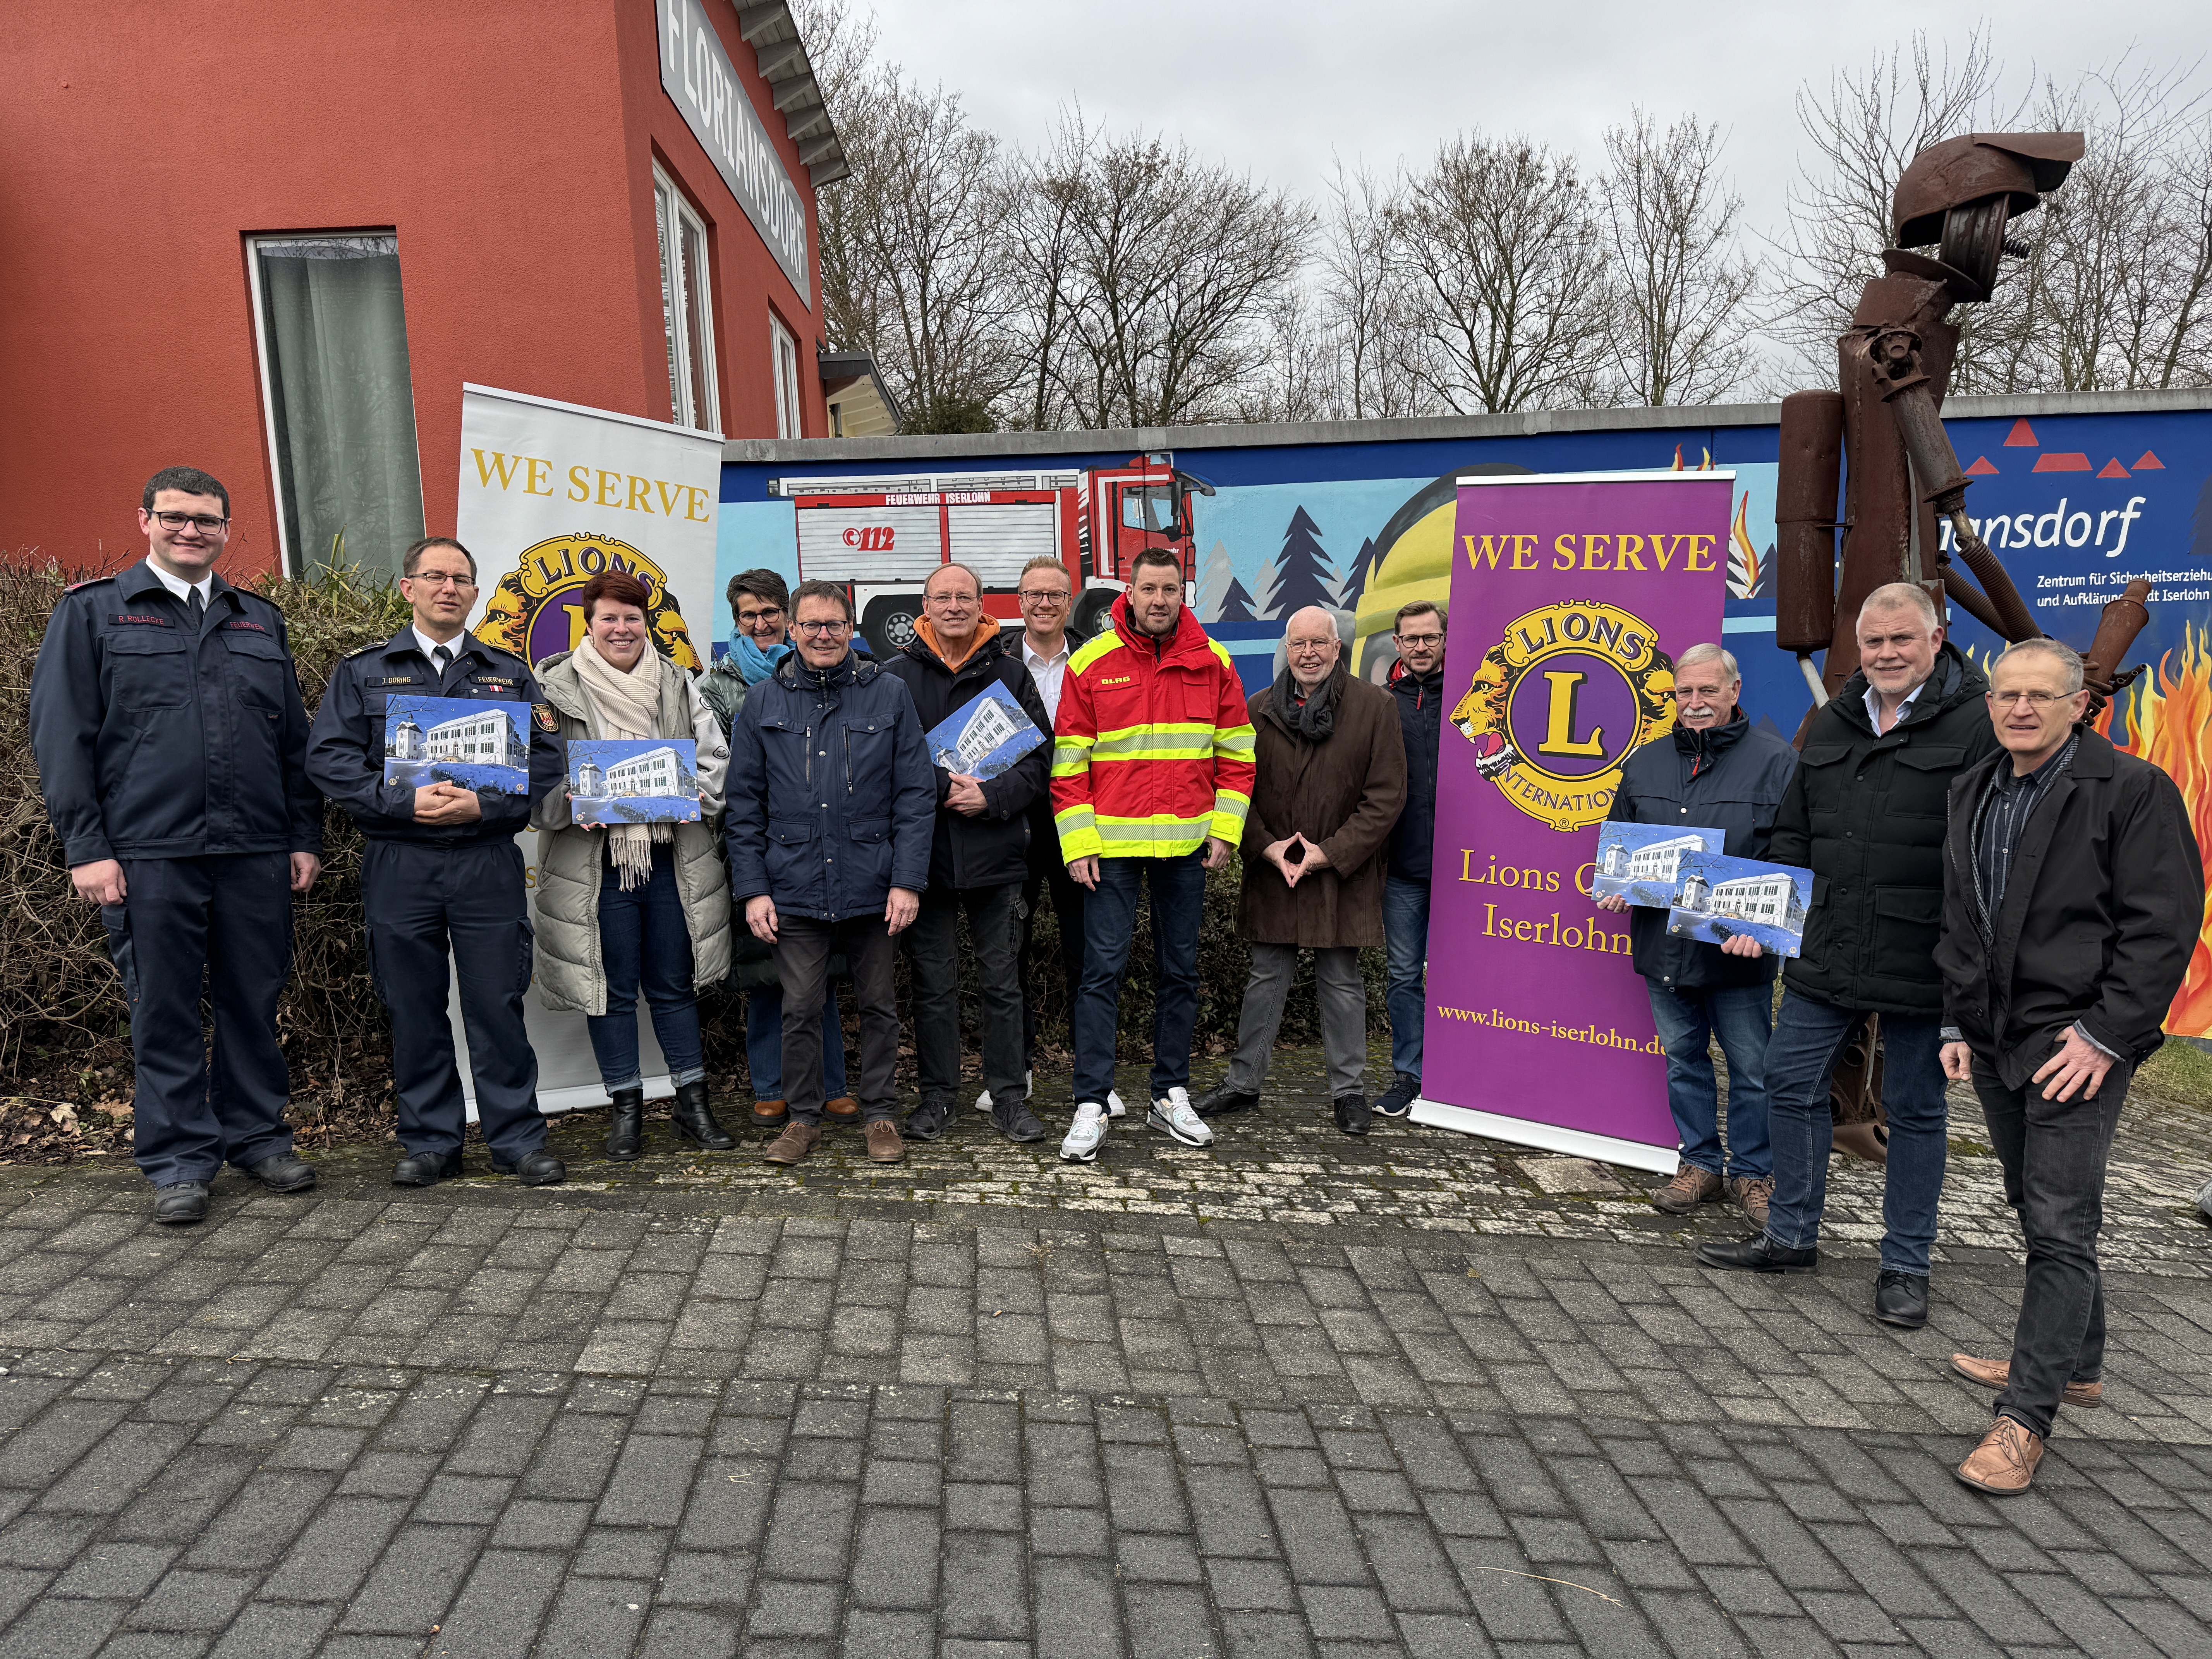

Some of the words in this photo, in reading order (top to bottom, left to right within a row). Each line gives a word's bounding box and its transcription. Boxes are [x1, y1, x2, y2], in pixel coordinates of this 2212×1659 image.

[668, 0, 803, 279] FLORIANSDORF
[471, 448, 554, 496] WE
[567, 465, 710, 522] SERVE
[885, 493, 941, 505] FEUERWEHR
[945, 491, 991, 503] ISERLOHN
[857, 526, 895, 551] 112
[1462, 534, 1539, 570] WE
[1553, 533, 1717, 572] SERVE
[534, 546, 656, 598] LIONS
[2037, 575, 2085, 588] Zentrum
[2089, 572, 2107, 585] für
[2037, 594, 2060, 607] und
[2162, 588, 2210, 601] Iserlohn
[127, 615, 164, 625] ROLLECKE
[1515, 612, 1647, 660] LIONS
[477, 676, 514, 685] FEUERWEHR
[1537, 670, 1608, 761] L
[1458, 849, 1561, 892] Lions
[1482, 903, 1633, 956] Iserlohn
